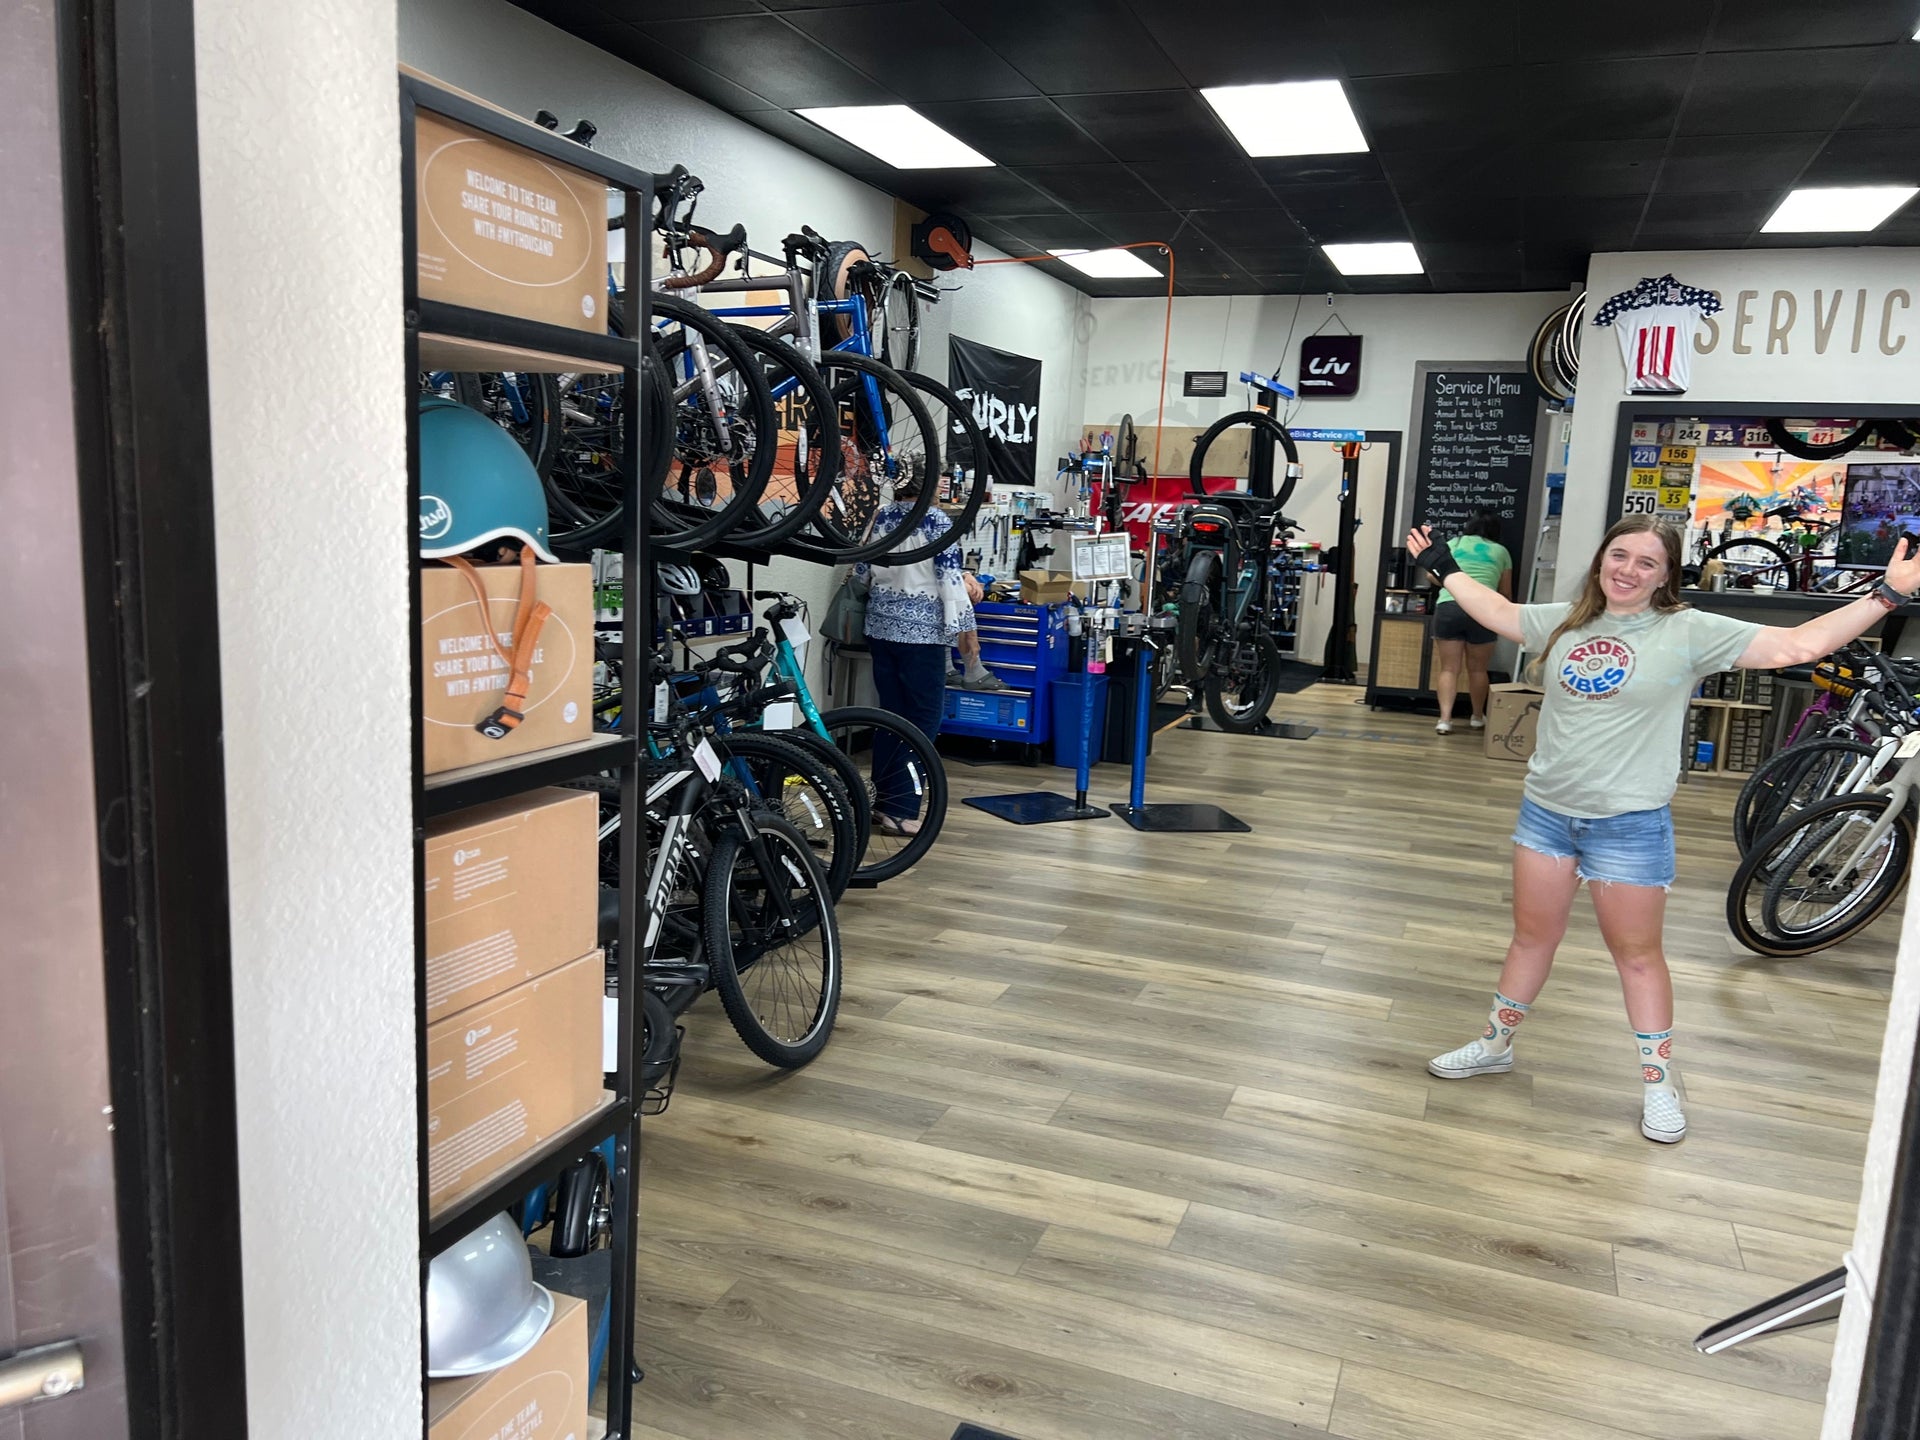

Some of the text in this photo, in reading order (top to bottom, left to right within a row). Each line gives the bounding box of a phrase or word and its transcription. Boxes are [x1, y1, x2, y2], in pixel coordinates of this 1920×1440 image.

[466, 169, 506, 201] WELCOME
[508, 184, 519, 201] TO
[520, 188, 535, 206] THE
[461, 191, 563, 239] SHARE YOUR RIDING STYLE
[473, 218, 496, 240] WITH
[1309, 357, 1351, 375] Liv
[1435, 374, 1520, 395] Service Menu
[1312, 431, 1343, 439] Service
[1634, 429, 1648, 438] 56
[1679, 429, 1702, 440] 242
[1713, 429, 1733, 441] 34
[1747, 431, 1769, 442] 316
[1812, 432, 1835, 444] 471
[1633, 451, 1657, 463] 220
[1668, 449, 1688, 459] 156
[1637, 474, 1654, 485] 388
[1624, 496, 1656, 514] 550
[1666, 494, 1682, 504] 35
[438, 635, 483, 655] WELCOME
[1567, 641, 1629, 668] RIDES
[433, 658, 464, 678] SHARE
[465, 656, 489, 673] YOUR
[1563, 664, 1625, 693] VIBES
[446, 679, 471, 697] WITH
[1586, 687, 1620, 700] MUSIC
